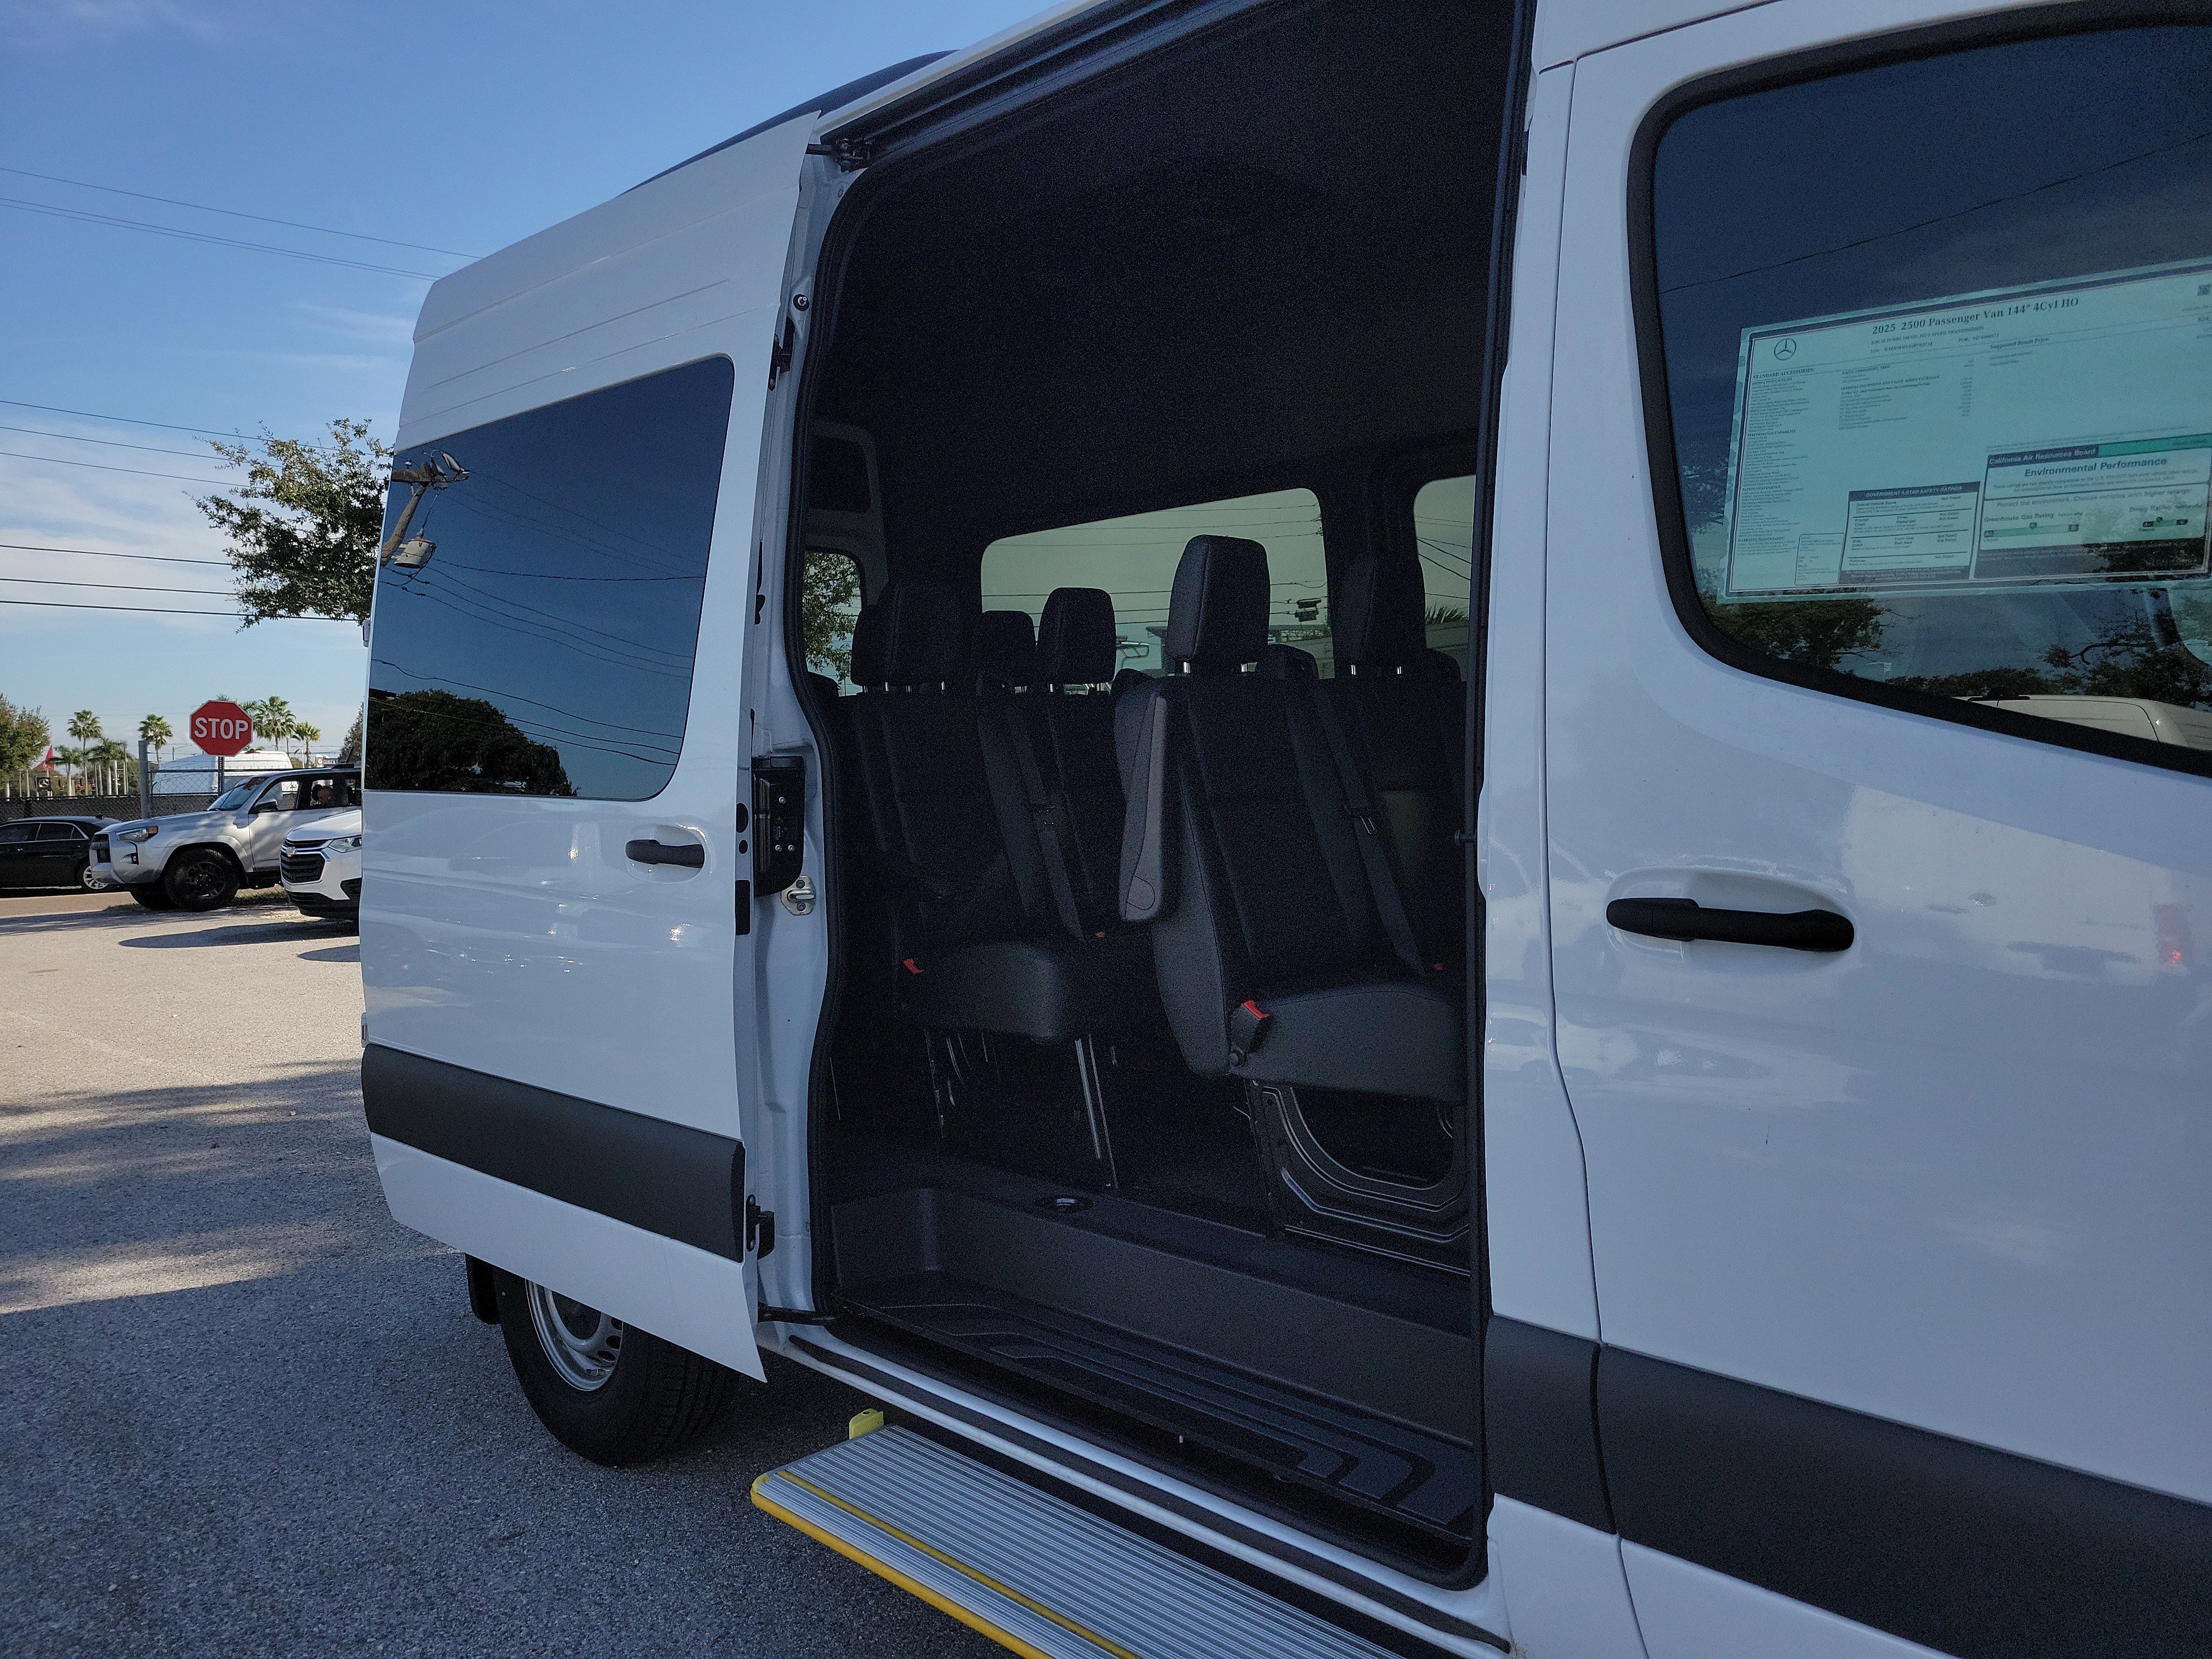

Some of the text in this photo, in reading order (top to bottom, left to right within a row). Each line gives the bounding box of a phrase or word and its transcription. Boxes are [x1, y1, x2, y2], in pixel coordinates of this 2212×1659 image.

[1872, 324, 1895, 335] 2025
[1901, 319, 1925, 330] 2500
[1928, 313, 1980, 326] Passenger
[1984, 310, 2003, 319] Van
[2033, 301, 2058, 312] 4Cyl
[2062, 298, 2079, 308] HO
[1990, 456, 2021, 465] California
[2025, 463, 2096, 477] Environmental
[2101, 459, 2167, 470] Performance
[194, 717, 249, 740] STOP
